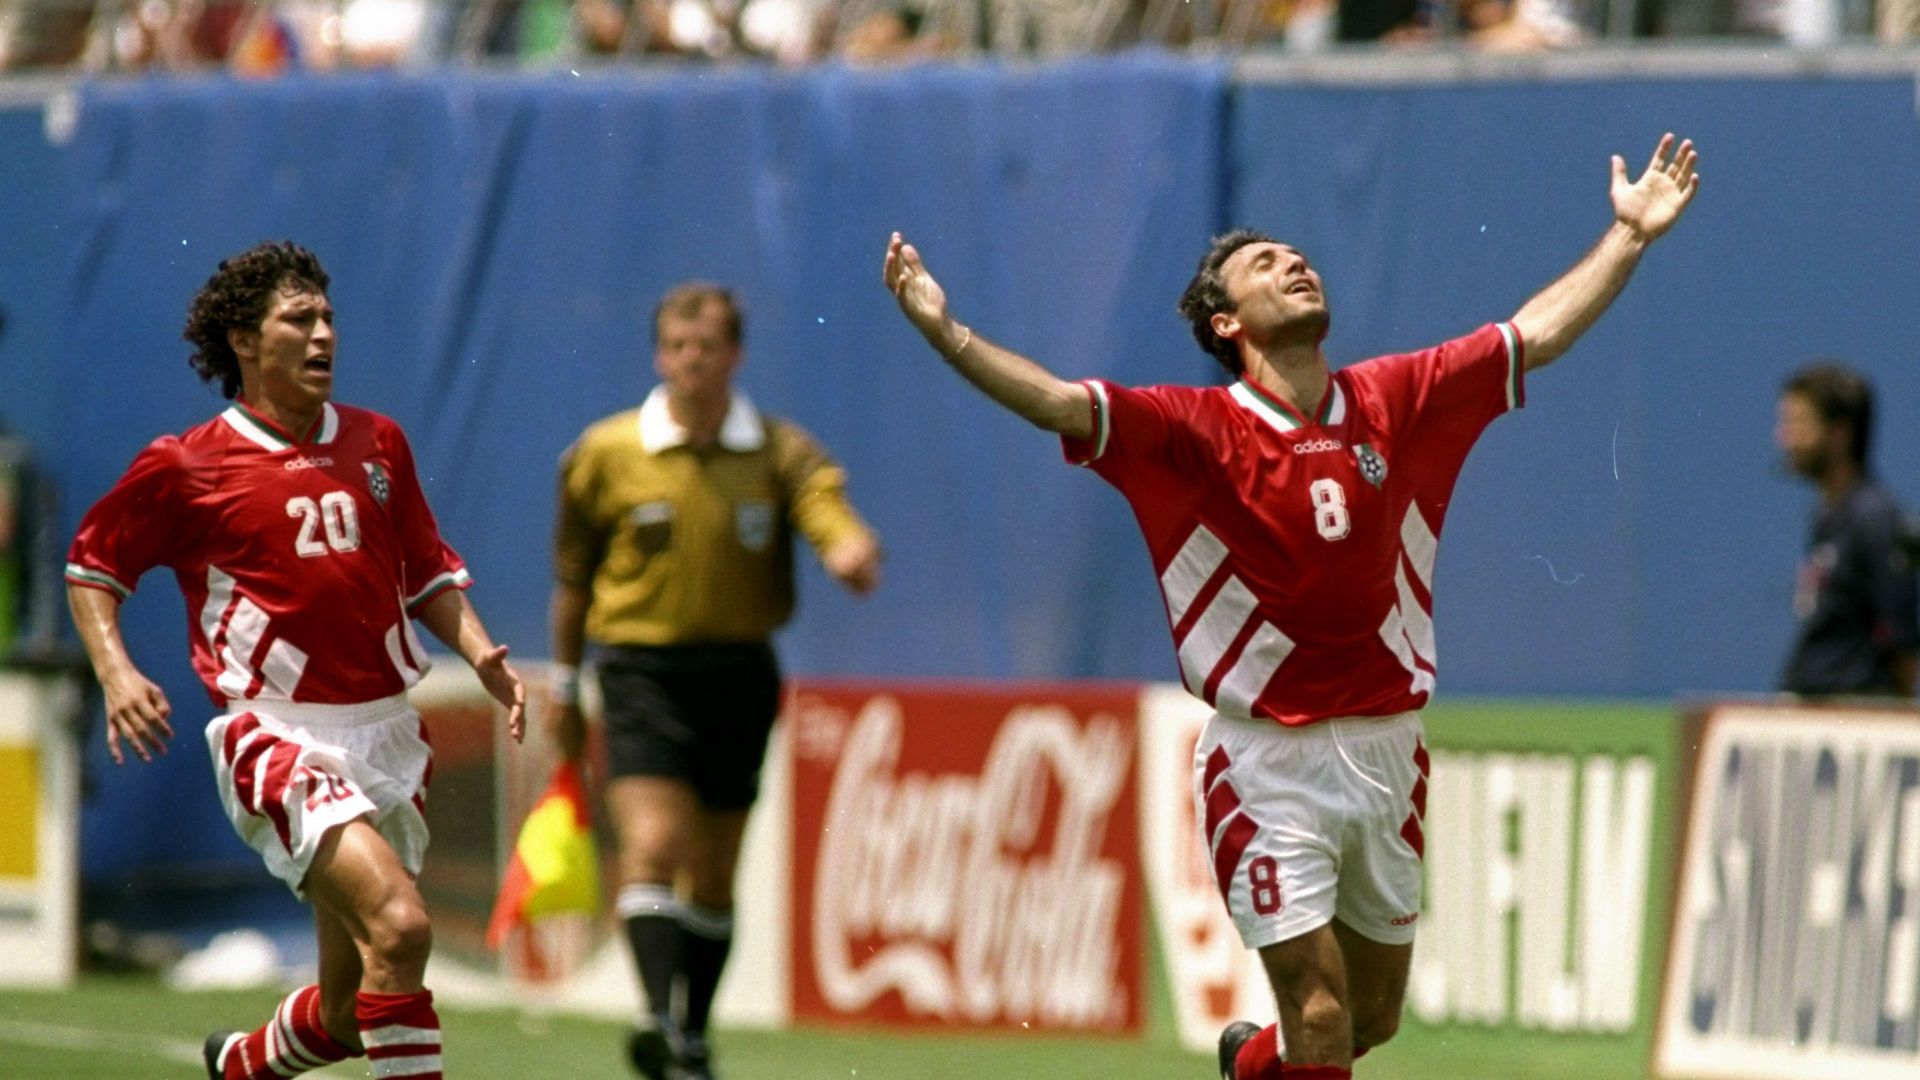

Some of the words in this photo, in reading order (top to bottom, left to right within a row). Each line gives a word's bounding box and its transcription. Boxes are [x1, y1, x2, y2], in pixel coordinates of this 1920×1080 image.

[284, 453, 334, 471] adidas
[1293, 438, 1342, 455] adidas
[284, 490, 361, 558] 20
[1309, 477, 1351, 542] 8
[1248, 855, 1284, 917] 8
